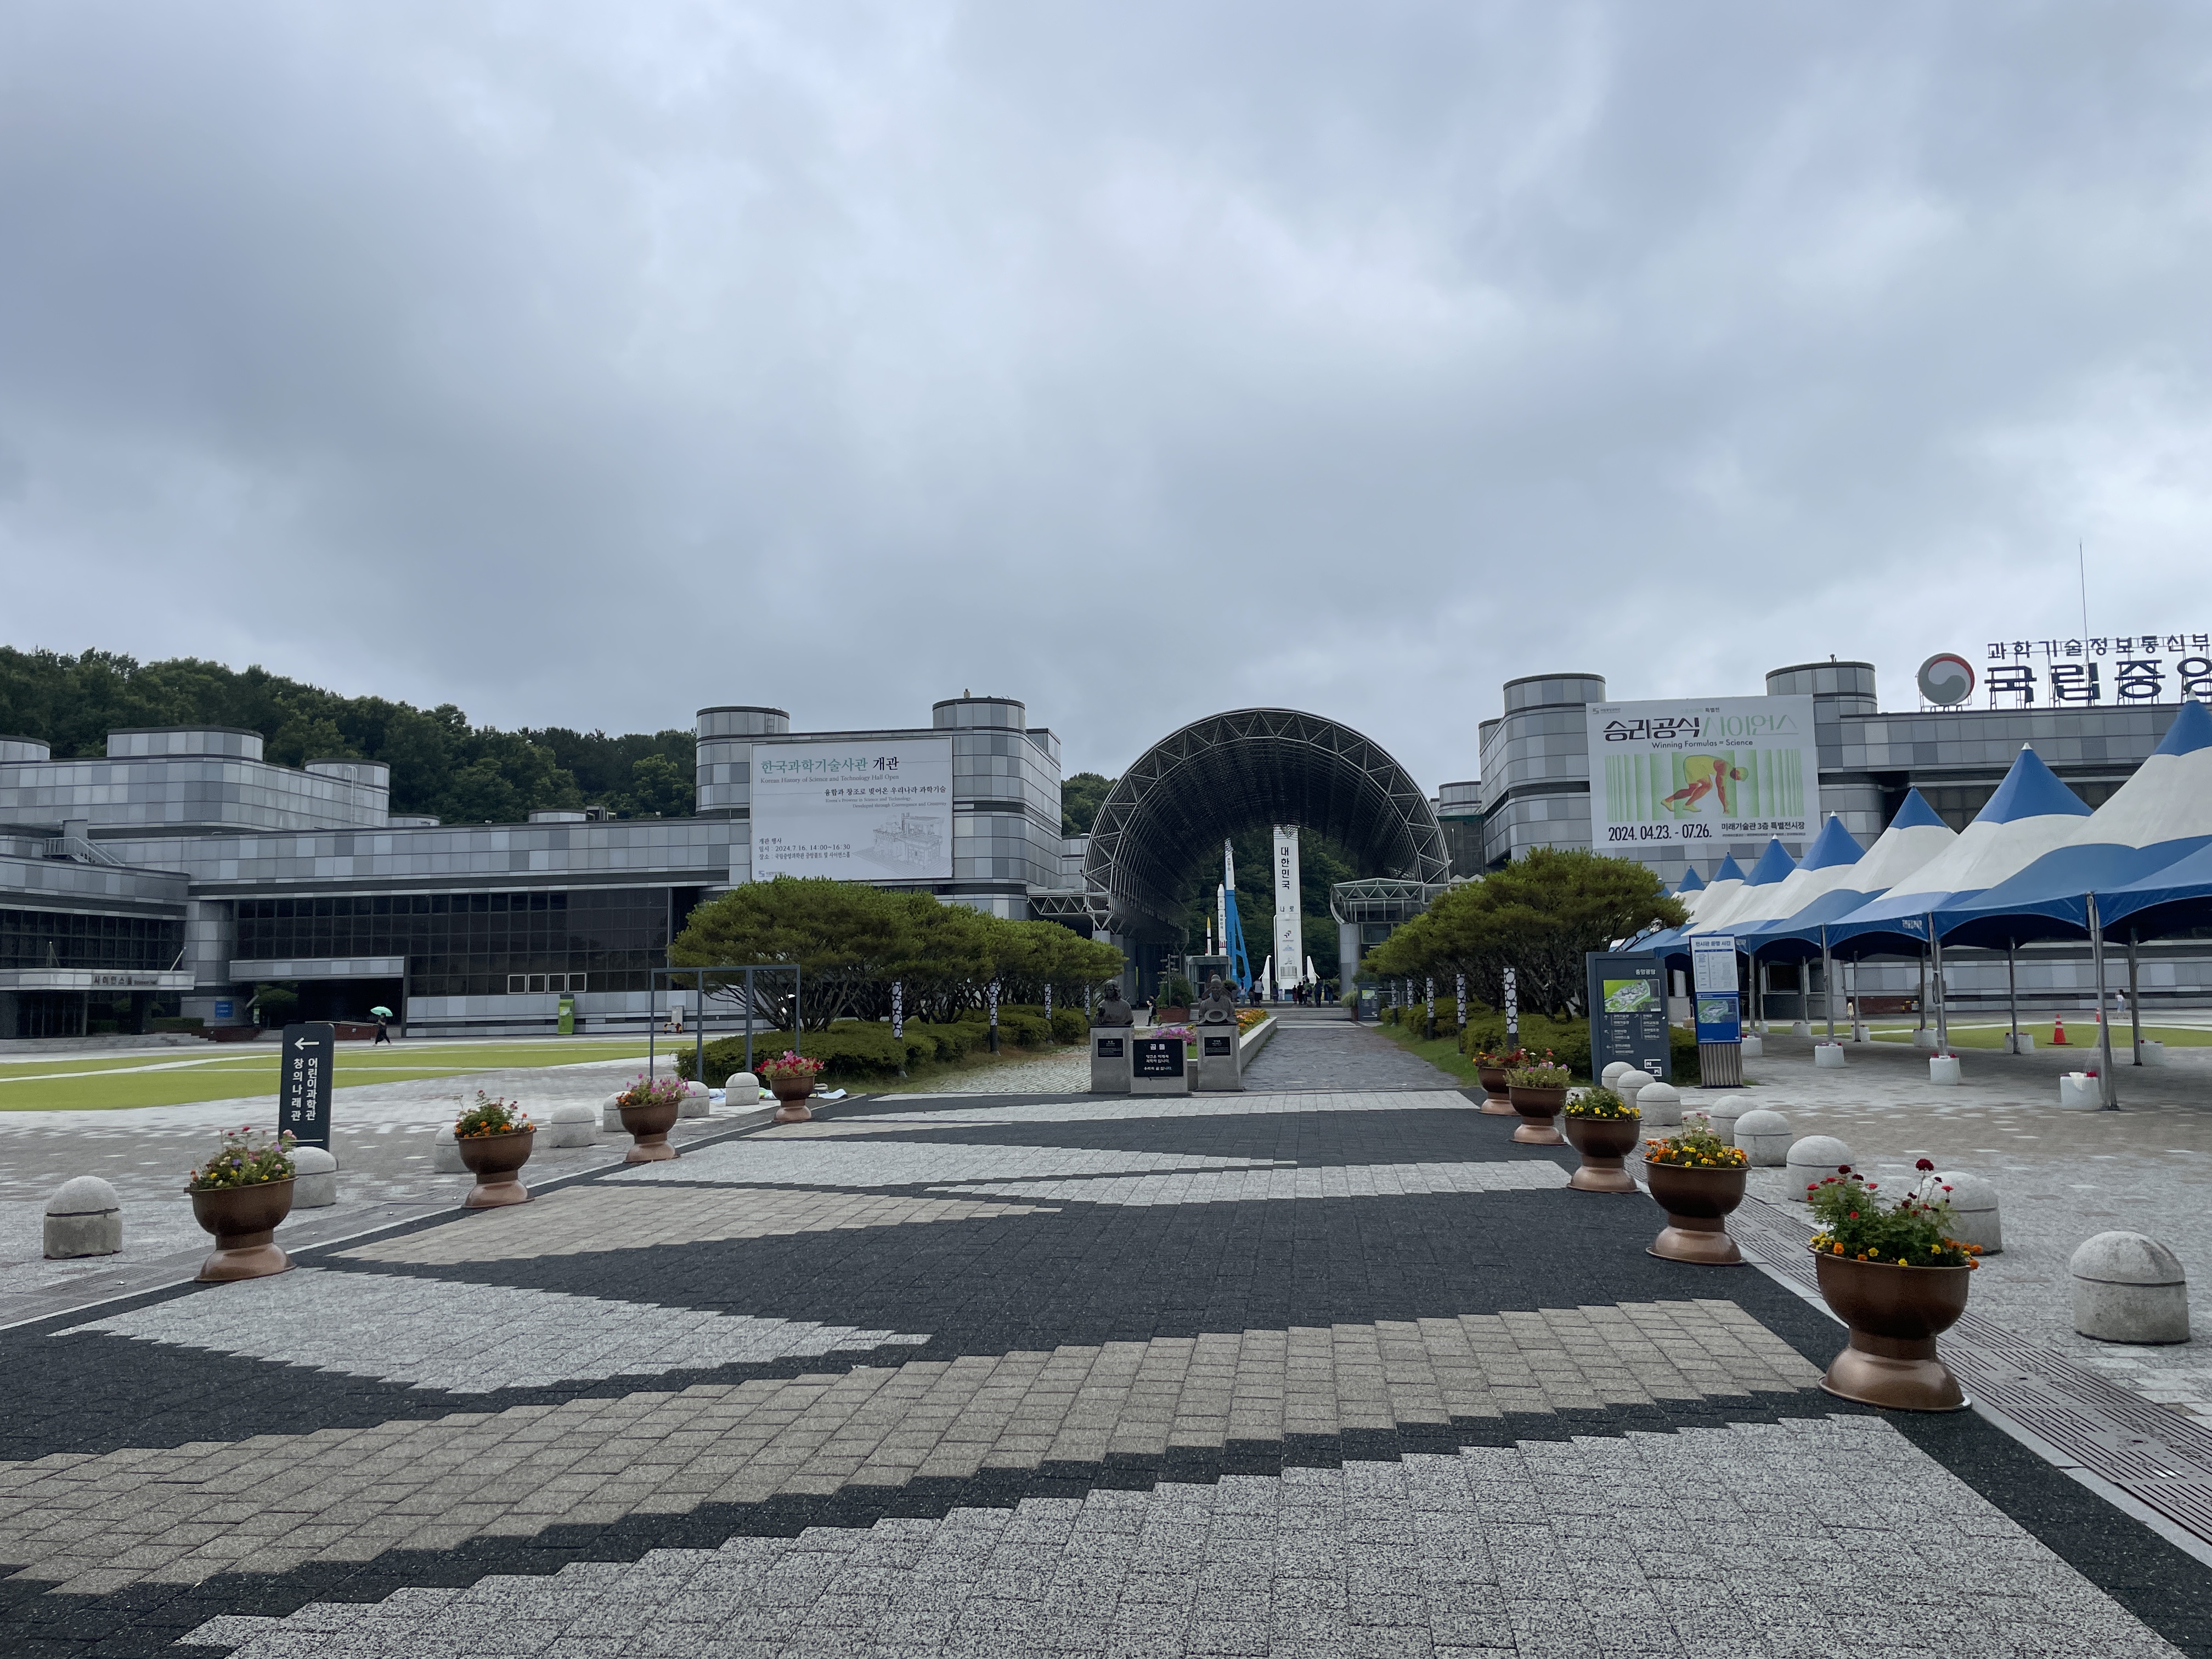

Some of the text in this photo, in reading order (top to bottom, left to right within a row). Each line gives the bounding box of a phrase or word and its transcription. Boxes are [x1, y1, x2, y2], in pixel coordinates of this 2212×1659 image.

[1988, 633, 2210, 659] 과학기술정보통신부
[1603, 717, 1700, 741] 승리공식
[761, 757, 899, 774] 한국과학기술사관 개관
[890, 786, 917, 794] 우리나라
[1609, 826, 1638, 841] 2024.
[1640, 825, 1672, 840] 04.23.
[1682, 823, 1712, 838] 07.26.
[1722, 822, 1756, 831] 미래기술관
[1771, 821, 1805, 830] 특별전시장
[1280, 847, 1290, 890] 대한민국
[291, 1058, 304, 1121] 창의나래관
[306, 1057, 318, 1121] 어린이과학관
